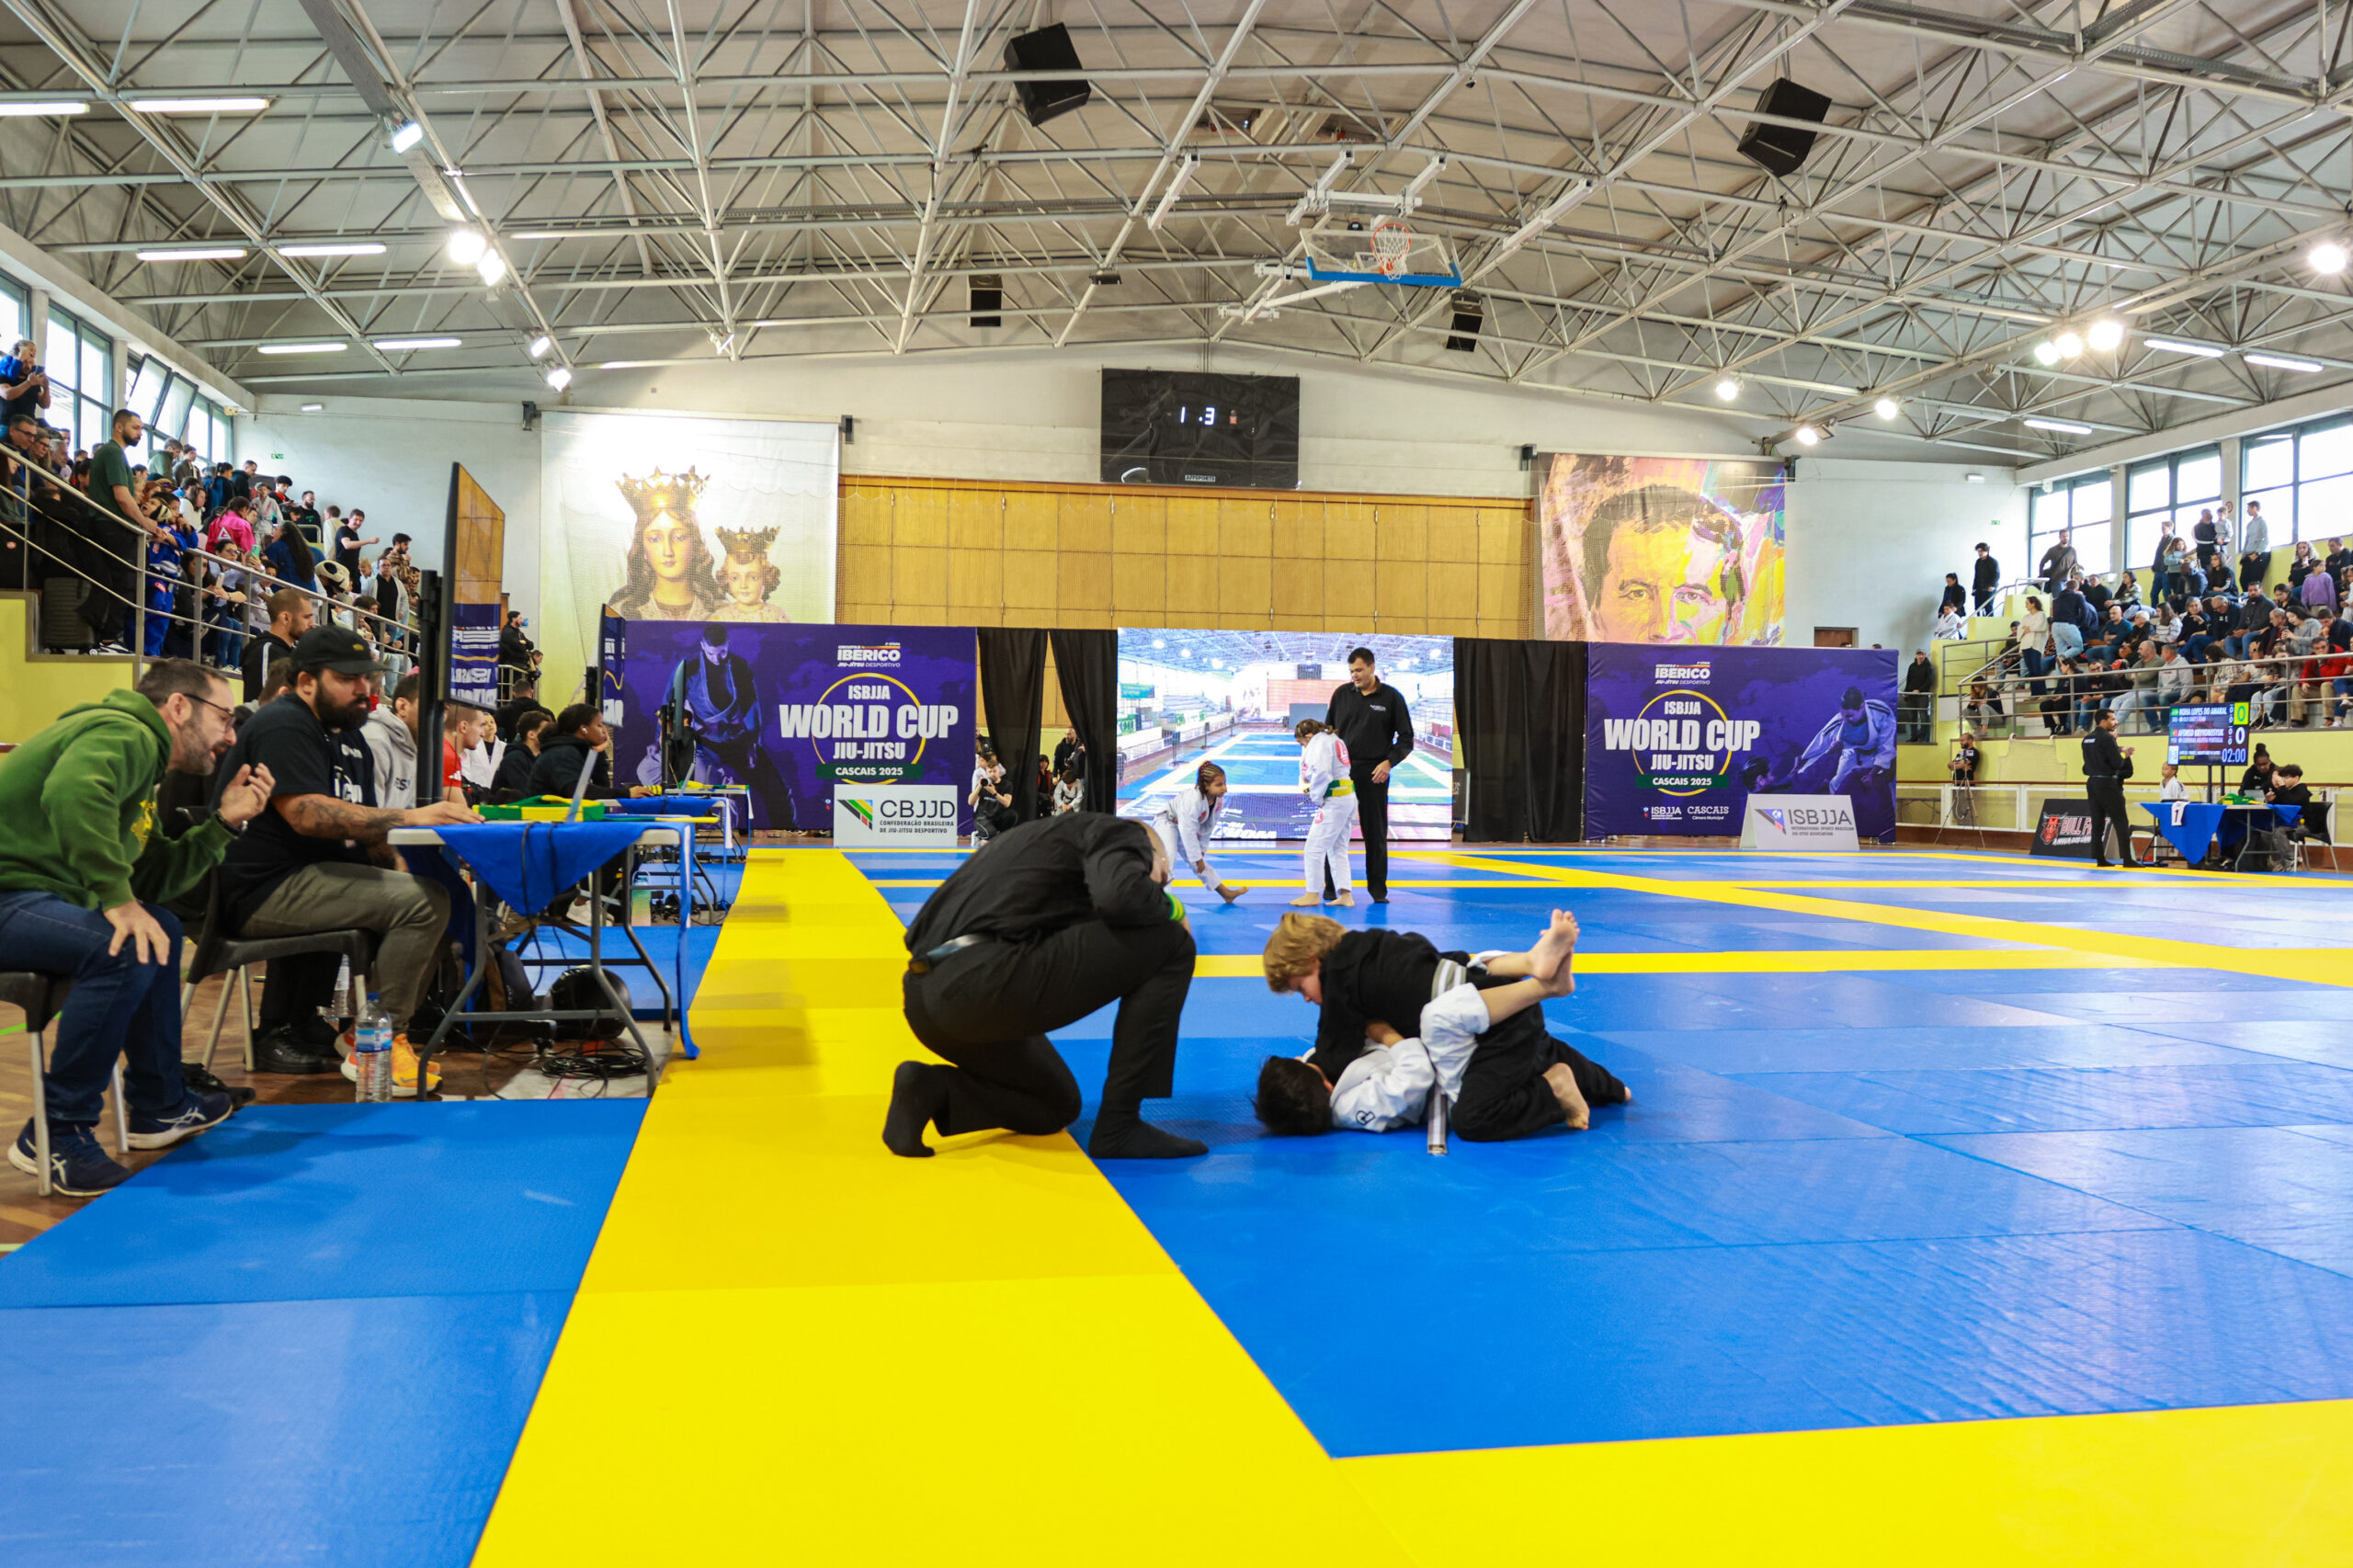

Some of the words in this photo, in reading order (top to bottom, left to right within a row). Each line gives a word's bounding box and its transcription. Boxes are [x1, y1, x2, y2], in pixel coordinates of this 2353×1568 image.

[848, 686, 891, 699] ISBJJA
[1665, 701, 1701, 715] ISBJJA
[2237, 706, 2246, 722] 0
[779, 704, 890, 739] WORLD
[896, 704, 959, 739] CUP
[1604, 719, 1700, 751] WORLD
[1706, 719, 1761, 751] CUP
[2235, 727, 2245, 744] 0
[833, 742, 906, 759] JIU-JITSU
[2222, 748, 2246, 763] 02:00
[1651, 755, 1714, 770] JIU-JITSU
[835, 767, 877, 776] CASCAIS
[879, 767, 904, 776] 2025
[880, 800, 956, 818] CBJJD
[1651, 806, 1682, 814] ISBJJA
[1687, 806, 1729, 814] CASCAIS
[1789, 809, 1852, 825] ISBJJA
[2060, 817, 2081, 835] BULL
